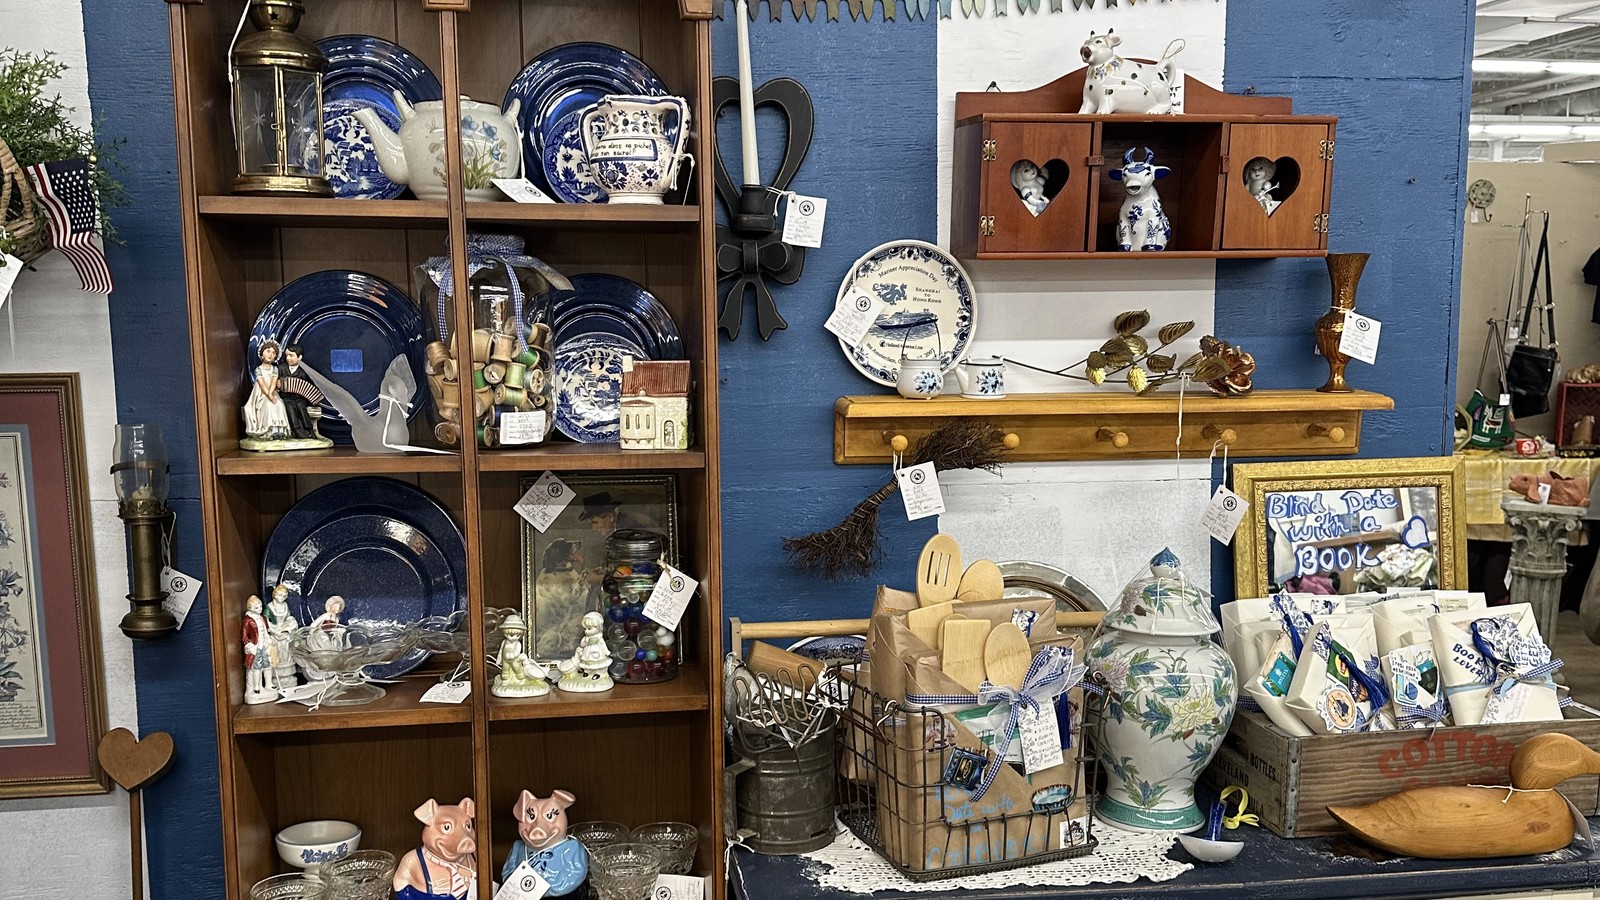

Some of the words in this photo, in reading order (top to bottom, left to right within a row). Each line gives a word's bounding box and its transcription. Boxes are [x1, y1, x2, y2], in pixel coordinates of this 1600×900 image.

[878, 266, 898, 278] Mariner
[899, 265, 929, 276] Appreciation
[928, 272, 938, 283] Day
[1267, 493, 1326, 519] Blind
[1340, 489, 1399, 512] Date
[1288, 512, 1350, 542] with
[1361, 515, 1382, 532] a
[1295, 543, 1380, 577] BOOK
[1452, 643, 1485, 667] BOOK
[1453, 656, 1485, 678] LOVER
[1213, 752, 1249, 787] LEVELAND
[1250, 752, 1276, 781] BOTTLES
[981, 794, 1014, 813] with
